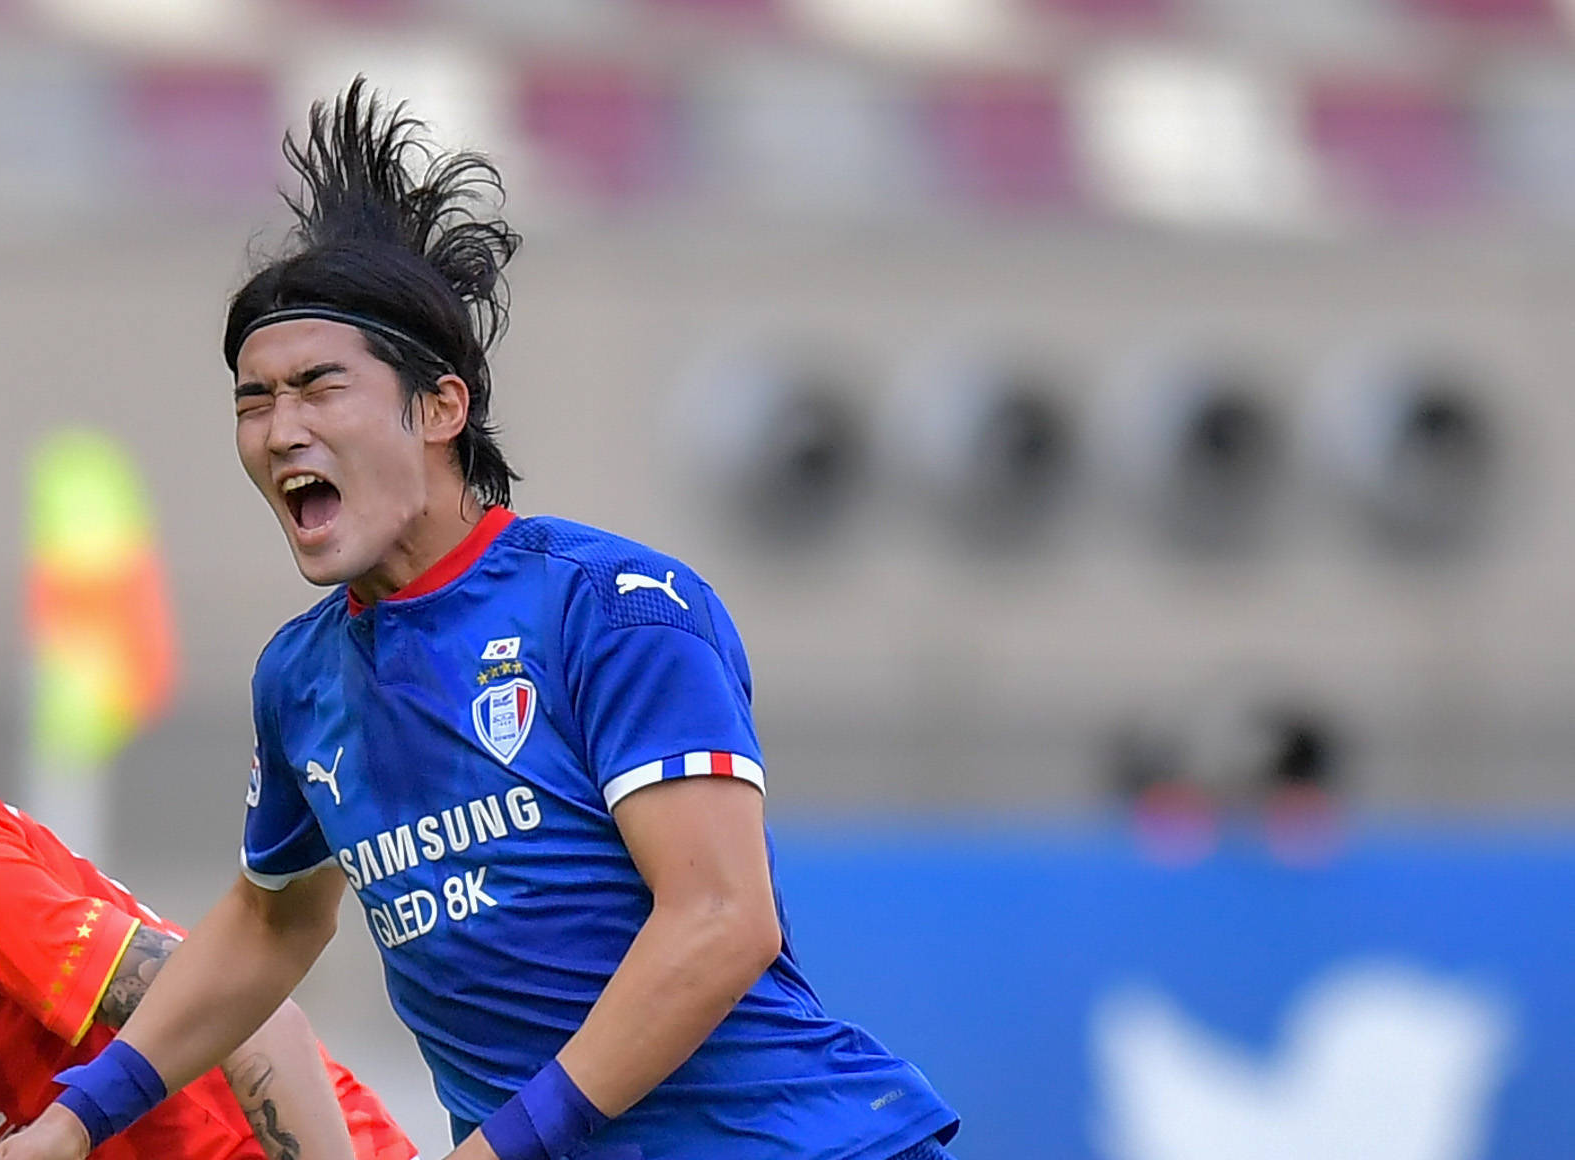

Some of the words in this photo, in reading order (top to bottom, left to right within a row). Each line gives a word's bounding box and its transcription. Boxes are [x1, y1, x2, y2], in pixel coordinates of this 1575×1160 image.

[339, 786, 542, 890] SAMSUNG
[371, 890, 438, 949] QLED
[443, 867, 498, 921] 8K
